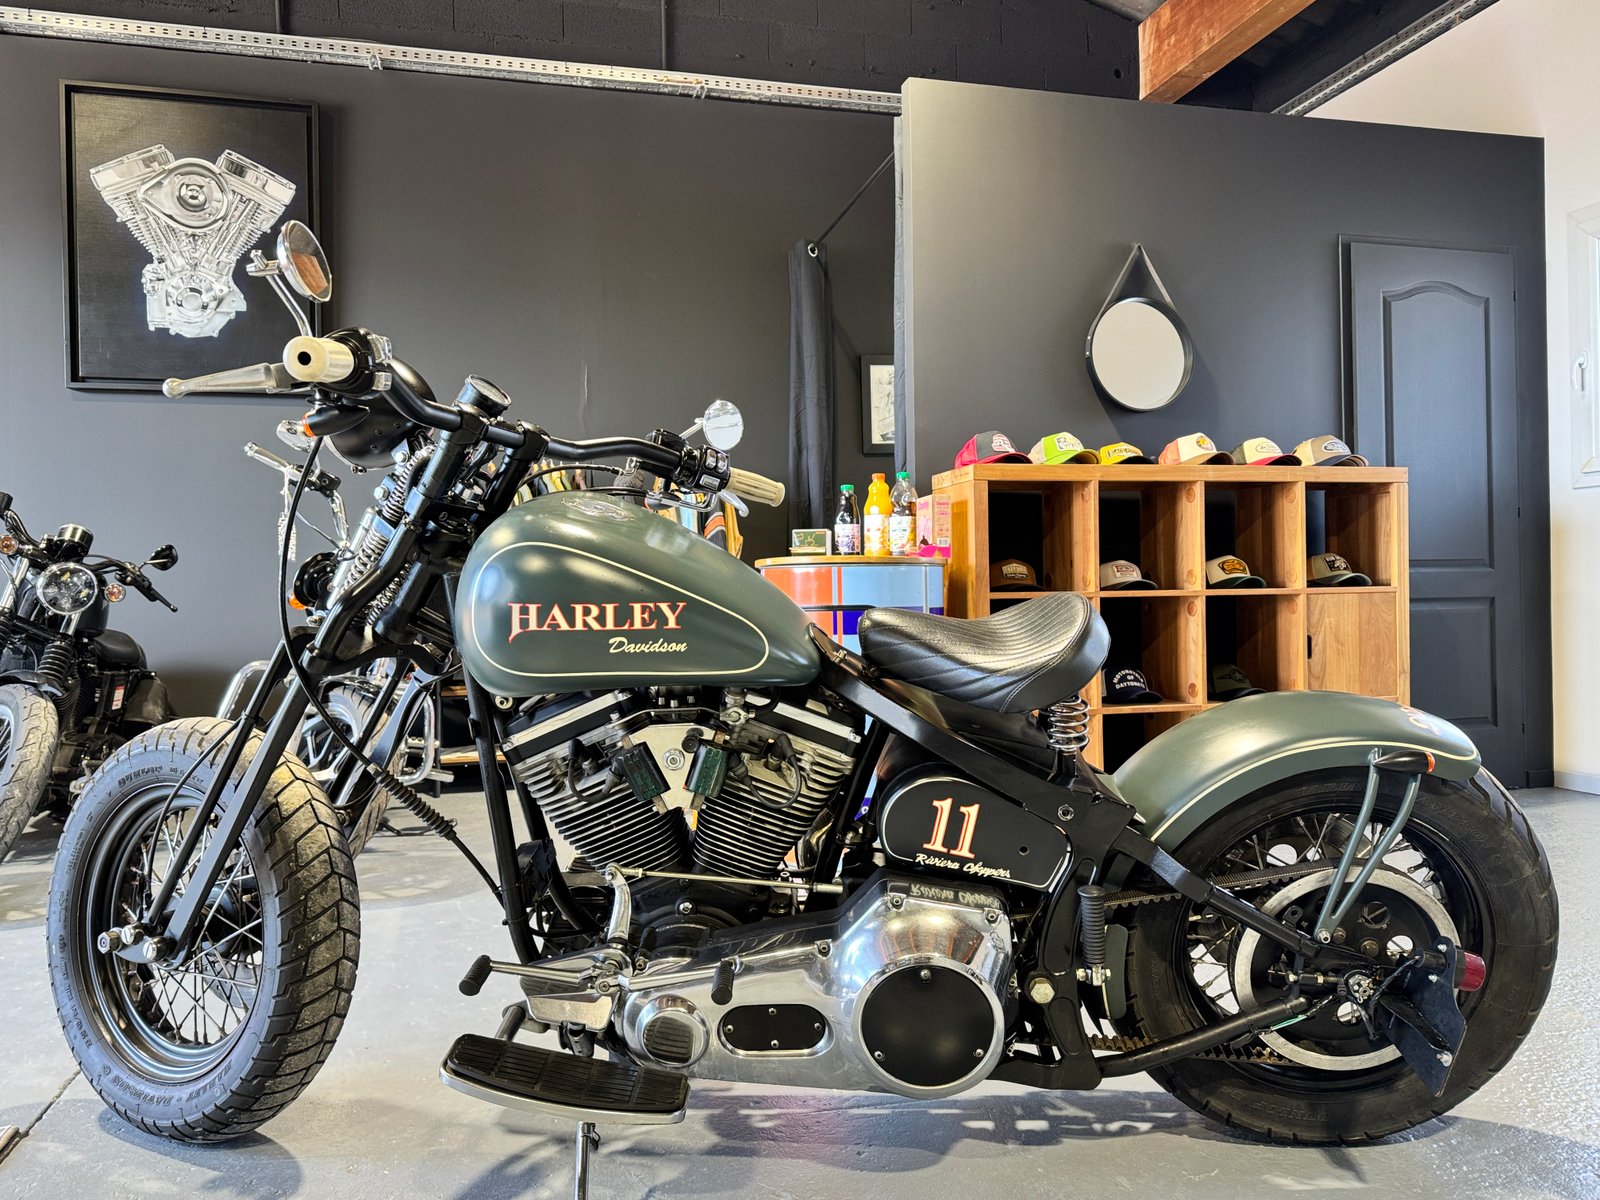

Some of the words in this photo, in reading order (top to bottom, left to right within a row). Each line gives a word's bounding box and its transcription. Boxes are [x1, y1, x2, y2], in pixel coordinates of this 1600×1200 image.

[508, 602, 687, 643] HARLEY
[608, 637, 688, 653] Davidson
[922, 797, 981, 860] 11
[915, 853, 960, 869] Riviera
[963, 861, 1011, 879] Choppers
